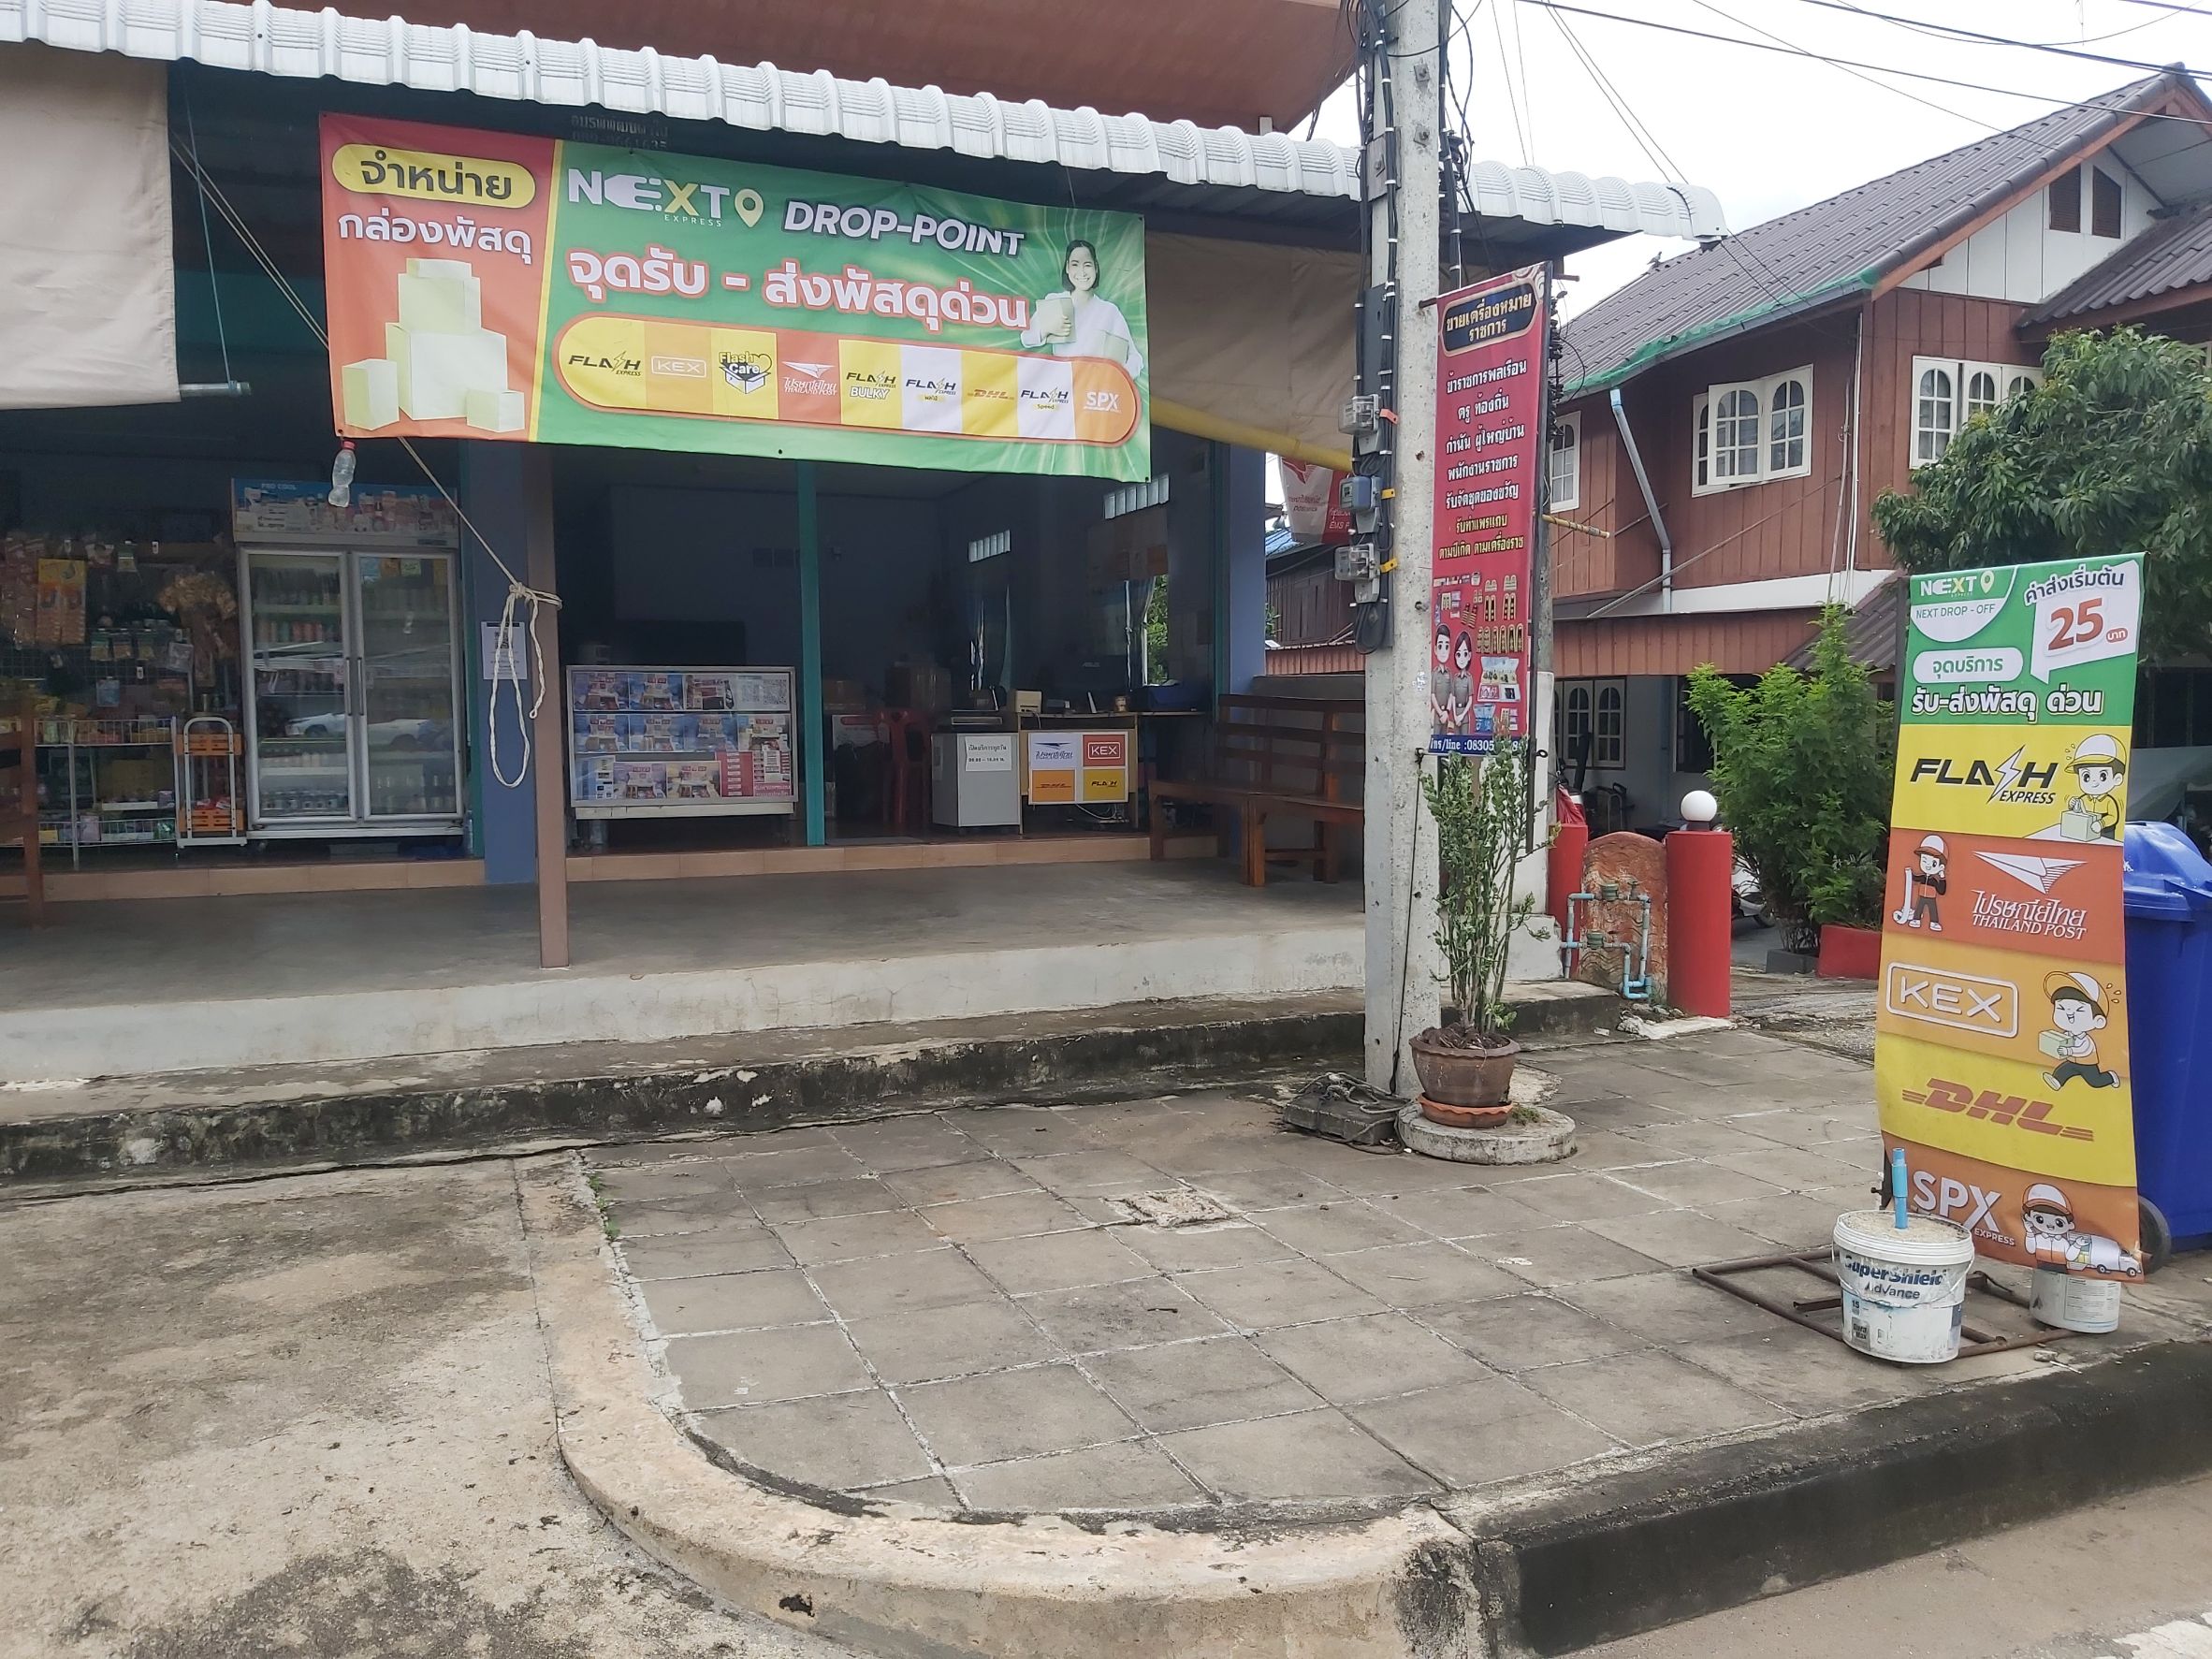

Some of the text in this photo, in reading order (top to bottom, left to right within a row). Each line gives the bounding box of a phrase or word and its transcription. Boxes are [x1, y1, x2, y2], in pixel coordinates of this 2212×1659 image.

[360, 150, 513, 200] จำหน่าย
[568, 168, 730, 219] NEXT
[664, 214, 722, 227] EXPRESS
[782, 200, 1024, 255] DROP-POINT
[338, 208, 532, 264] กล่องพัสดุ
[570, 246, 706, 298] จุดรับ
[766, 262, 1029, 331] ส่งพัสดุด่วน
[1447, 293, 1532, 331] ขายเครื่องหมาย
[1469, 318, 1506, 342] ราชการ
[657, 360, 702, 373] KEX
[719, 351, 754, 363] Flash
[729, 363, 760, 374] Care
[1447, 359, 1526, 393] ข้าราชการพลเรือน
[785, 386, 818, 395] THAILAND
[850, 387, 890, 400] BULKY
[973, 389, 1010, 400] DHL
[1086, 391, 1119, 410] SPX
[1458, 388, 1509, 423] ครู ท้องถิ่น
[1446, 433, 1471, 454] กำนัน
[1448, 455, 1519, 481] พนักงานราชการ
[1446, 480, 1520, 510] รับจัดชุดของขวัญ
[1920, 575, 1977, 597] NEXT
[2026, 566, 2124, 604] ค่าส่งเริ่มต้น
[1916, 608, 1938, 619] NEXT
[1941, 605, 1969, 618] DROP
[1977, 604, 1996, 615] OFF
[2047, 598, 2126, 651] 25 บาท
[1932, 657, 2003, 679] จุดบริการ
[1912, 684, 2103, 721] รับ-ส่งพัสดุ ด่วน
[1091, 746, 1117, 756] KEX
[1910, 748, 2058, 793] FLASH
[1999, 790, 2056, 805] EXPRESS
[1971, 889, 2087, 925] ไปรษณีย์ไทย
[1972, 913, 2087, 940] THAILAND POST
[1900, 975, 2001, 1023] KEX
[1924, 1078, 2063, 1135] DHL
[1913, 1170, 2001, 1233] SPX
[1974, 1227, 2016, 1246] EXPRESS
[1852, 1300, 1859, 1309] 15
